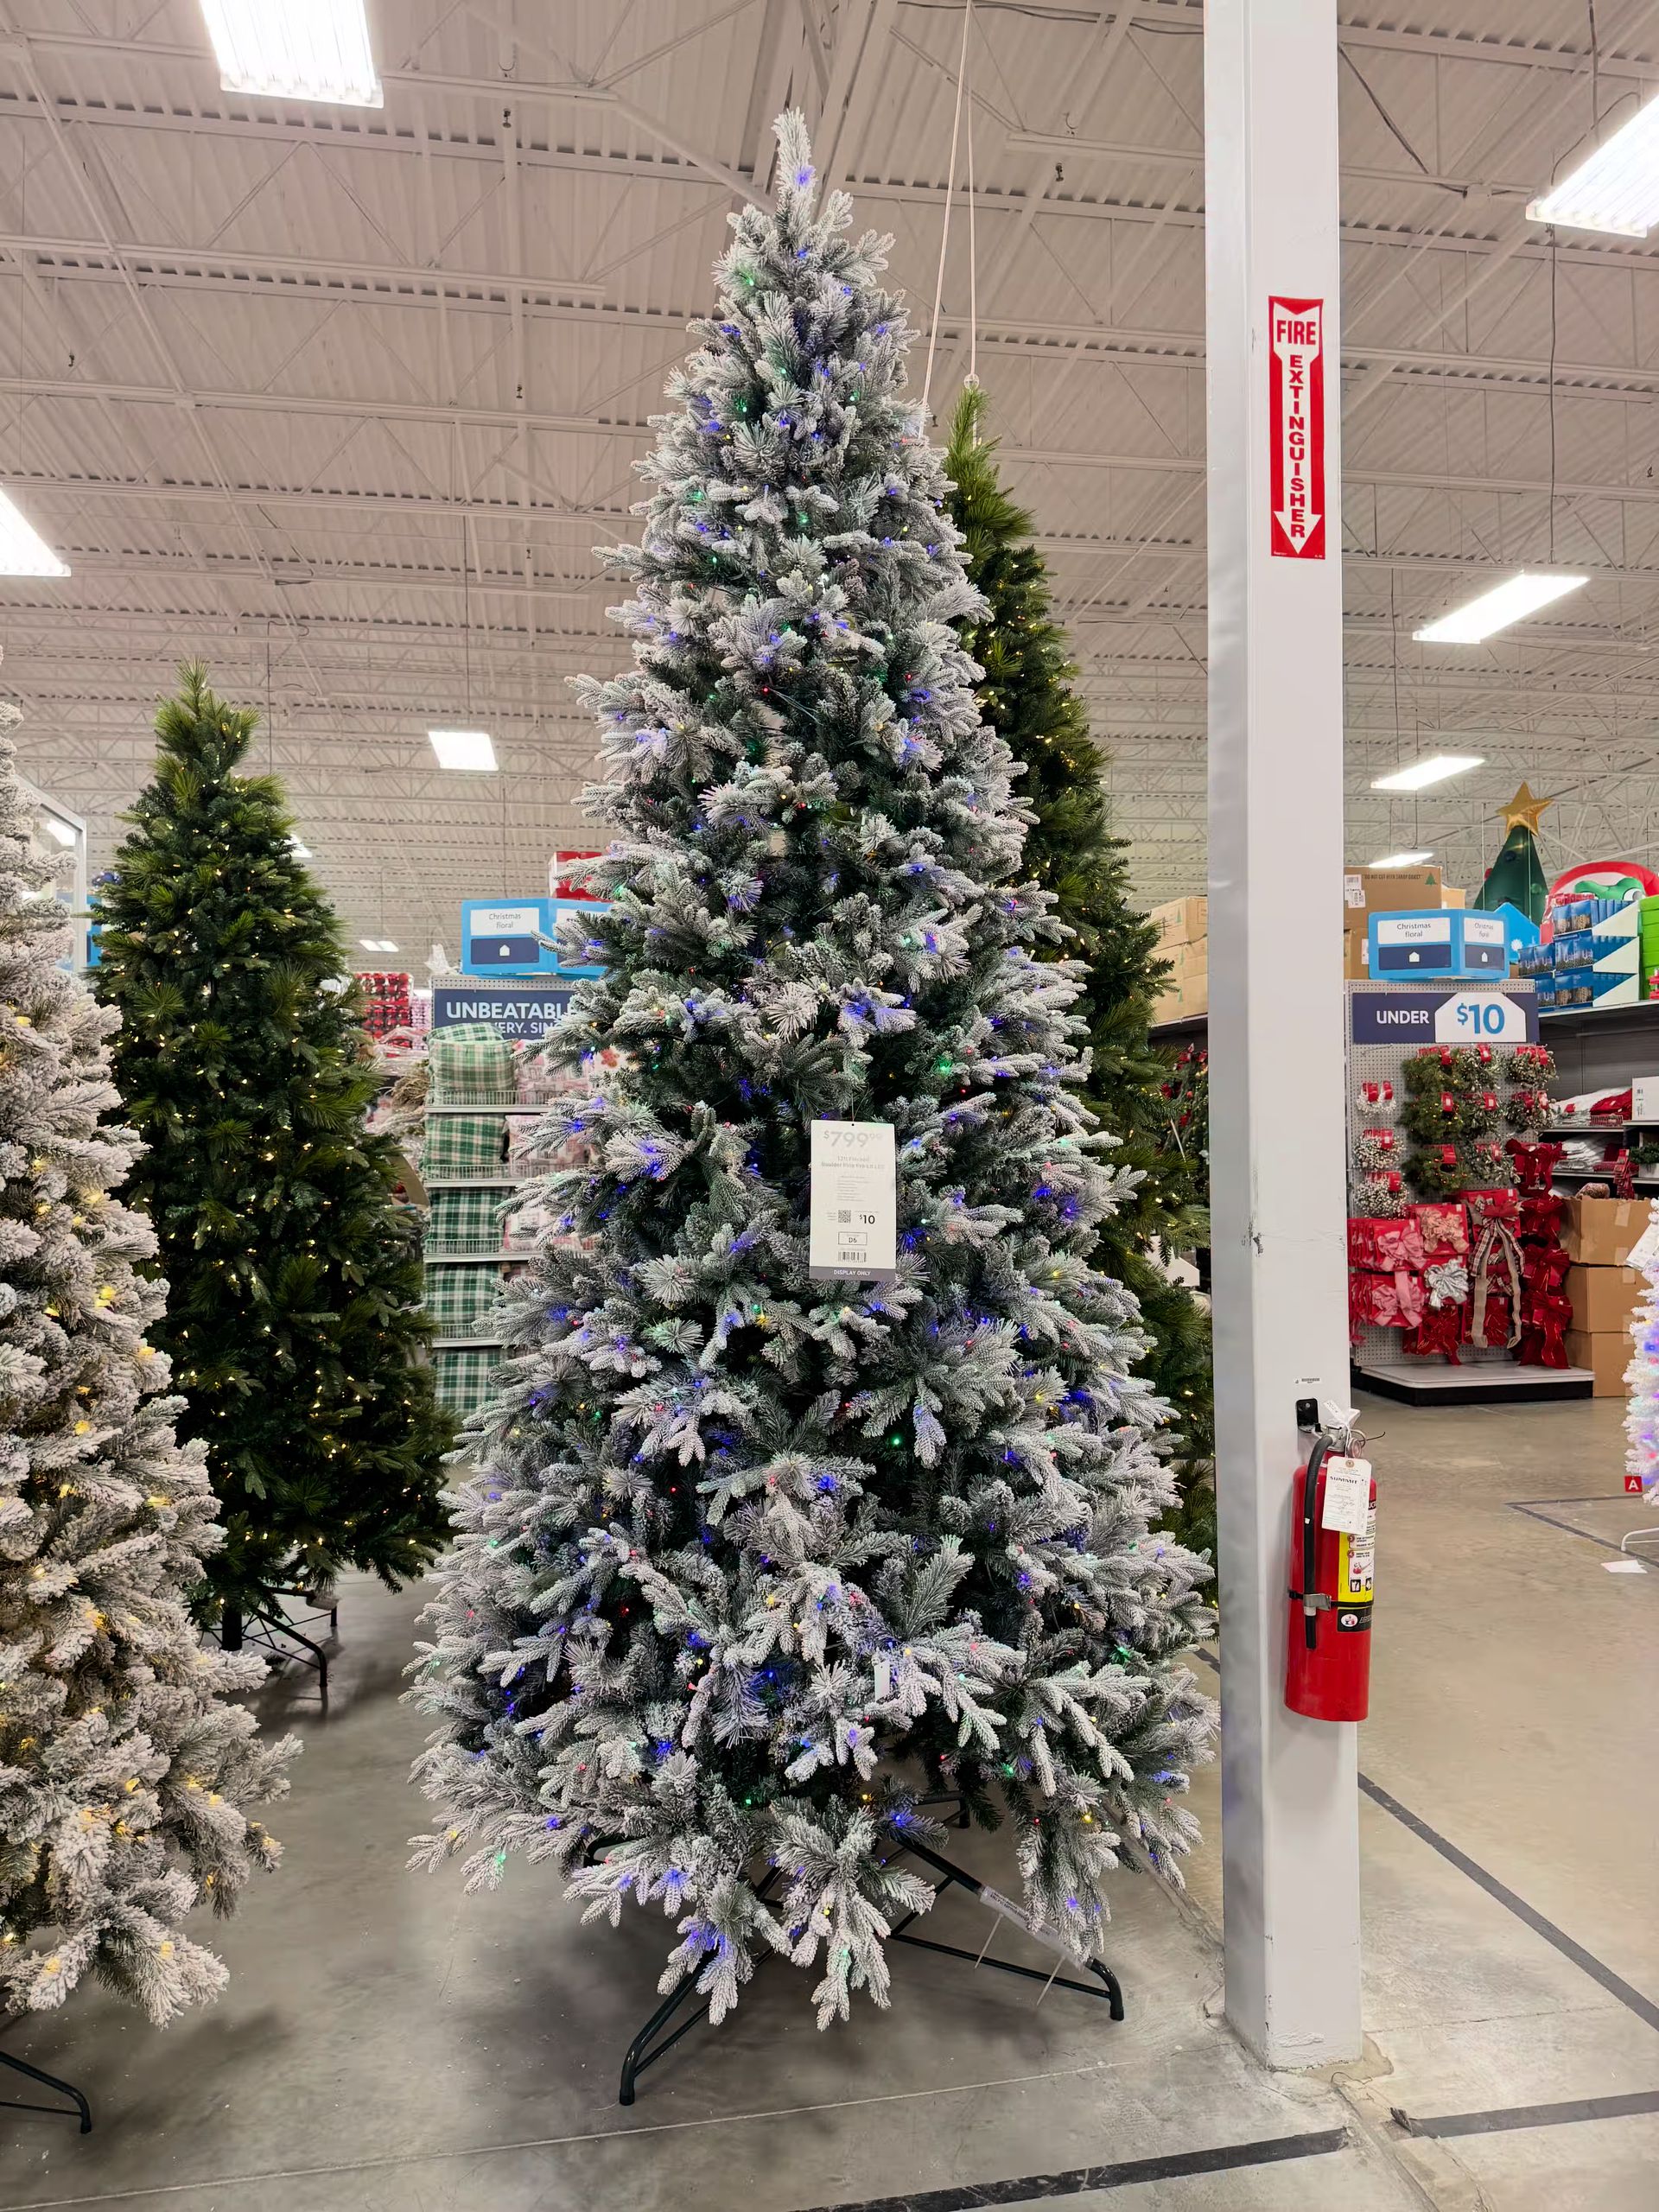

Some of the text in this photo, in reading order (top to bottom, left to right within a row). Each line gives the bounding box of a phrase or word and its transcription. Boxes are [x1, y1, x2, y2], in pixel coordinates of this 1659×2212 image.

[1276, 319, 1317, 346] FIRE
[1289, 354, 1306, 538] EXTINGUISHER
[494, 1021, 528, 1034] ERY.
[1376, 1002, 1505, 1034] UNDER $10
[859, 1214, 875, 1224] $10
[1628, 1478, 1639, 1491] A
